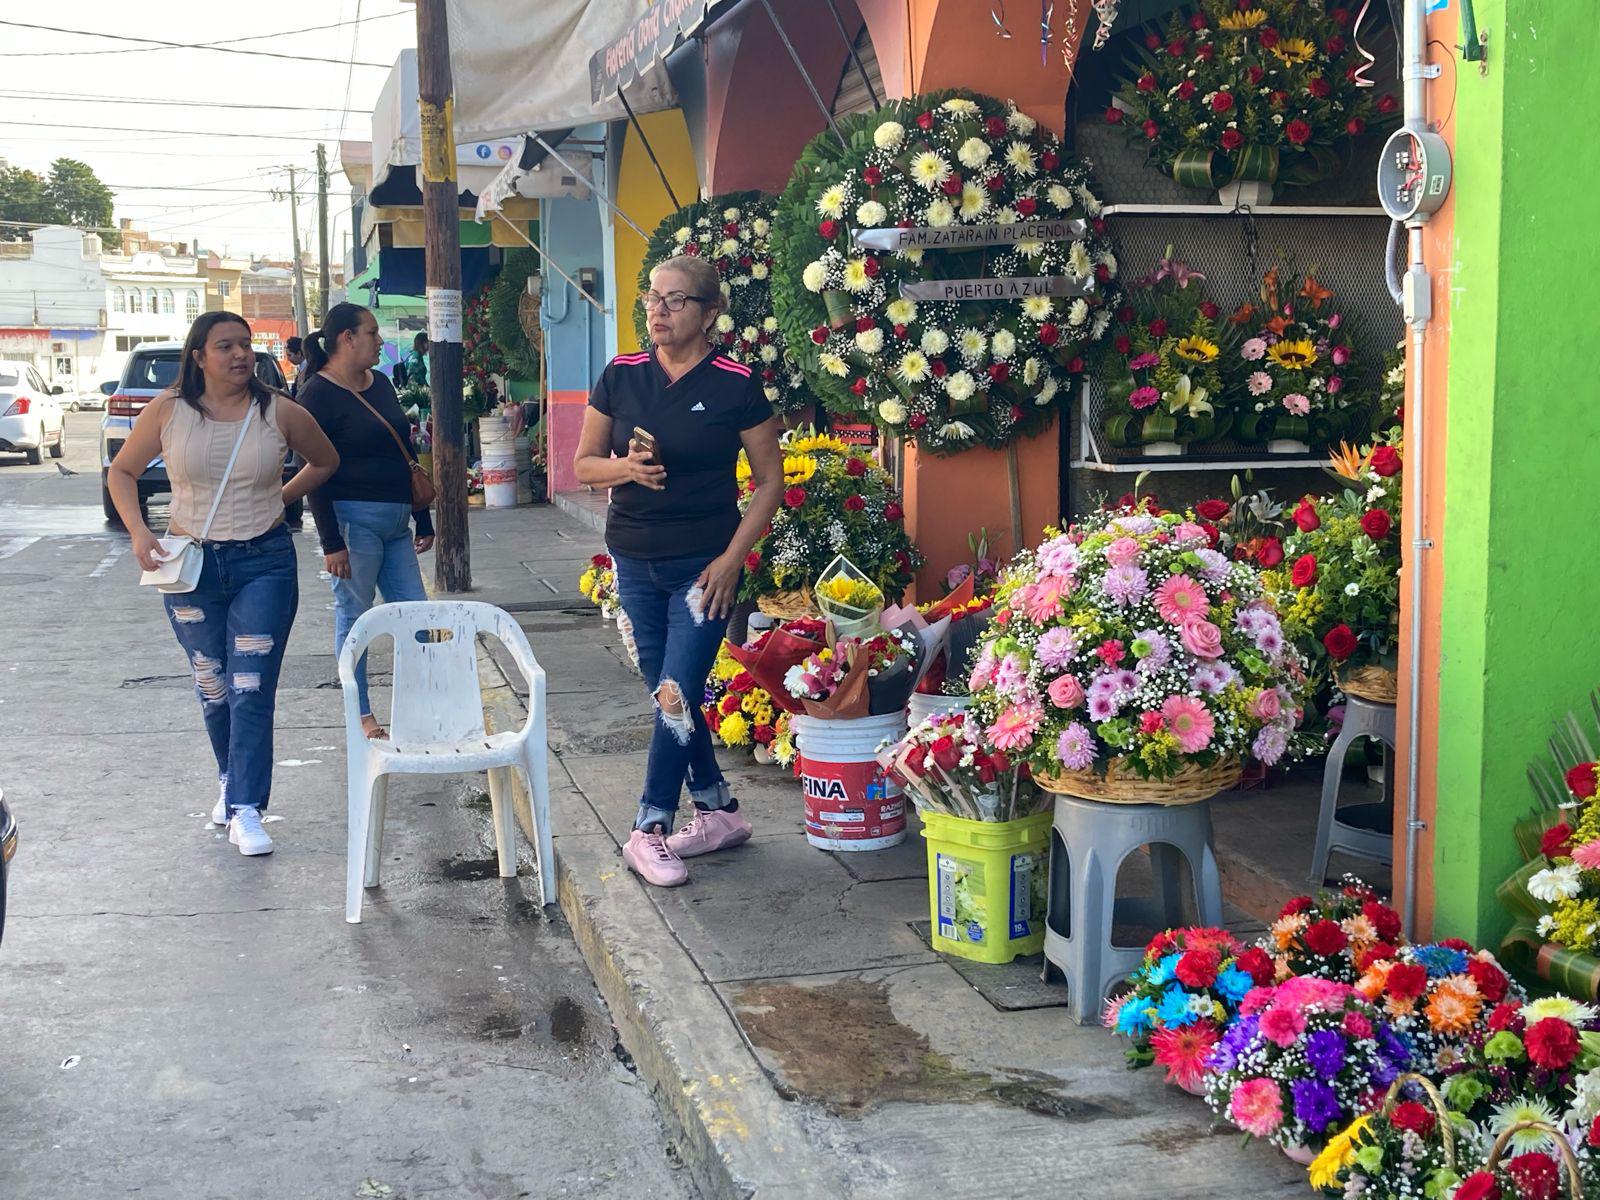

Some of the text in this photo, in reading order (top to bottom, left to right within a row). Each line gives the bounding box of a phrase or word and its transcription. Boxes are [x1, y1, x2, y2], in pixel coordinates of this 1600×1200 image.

[638, 4, 660, 52] Doña
[1004, 224, 1074, 240] PLACENCIA
[945, 281, 1053, 299] PUERTO AZUL
